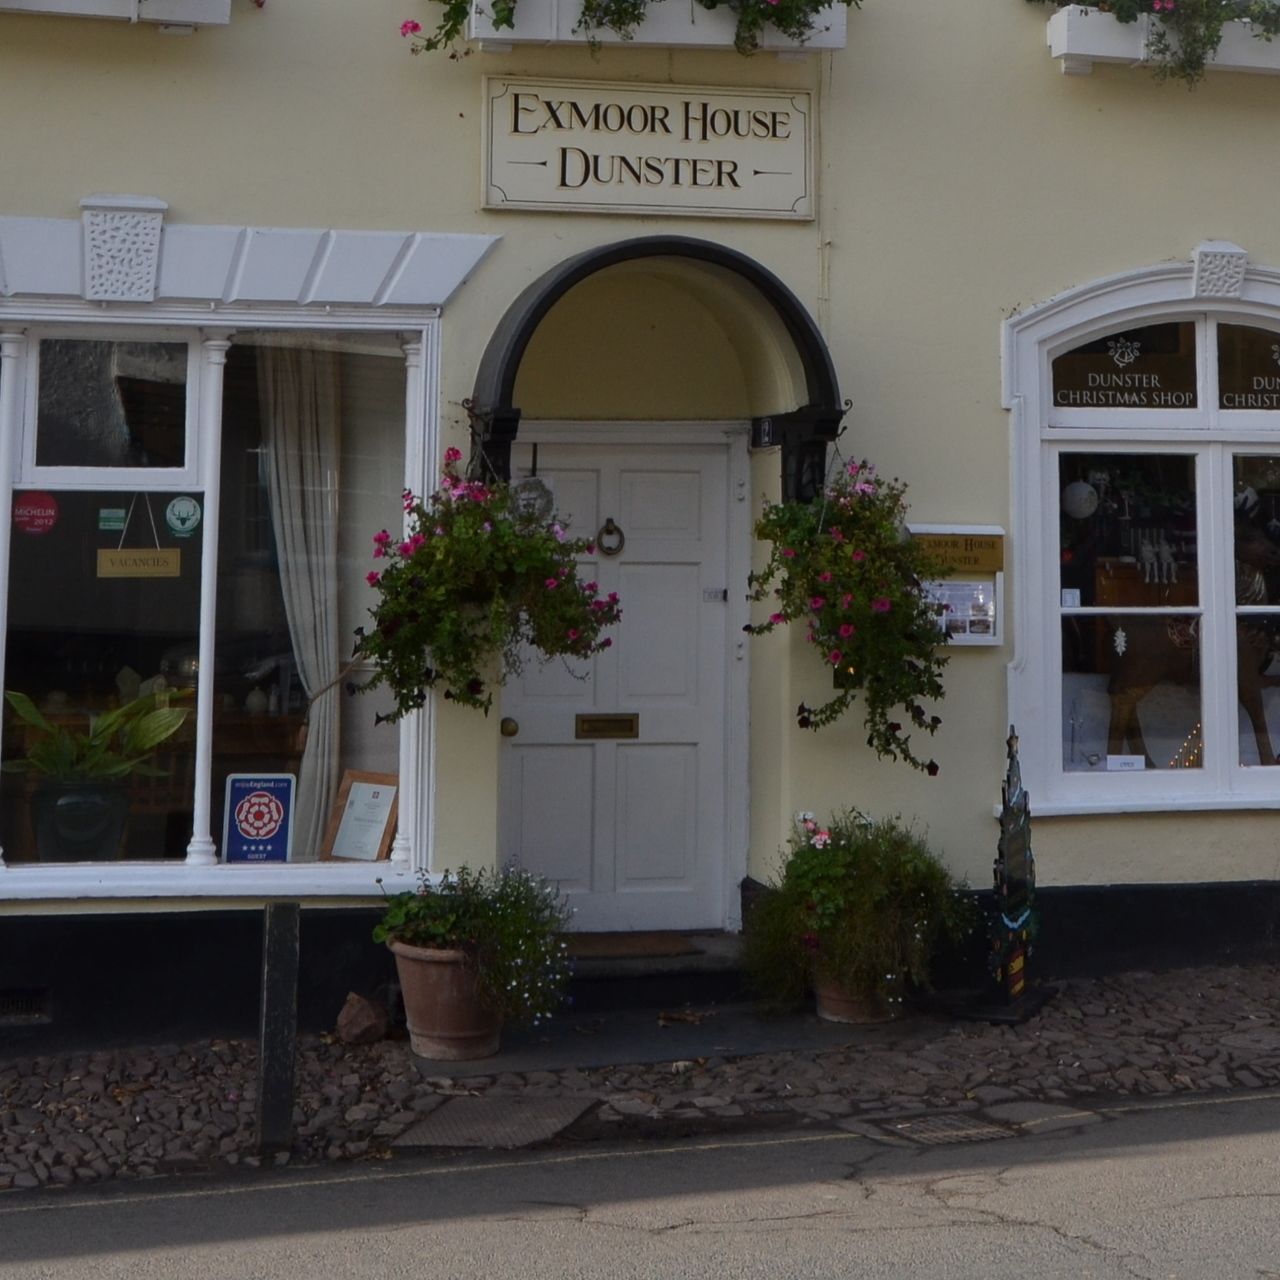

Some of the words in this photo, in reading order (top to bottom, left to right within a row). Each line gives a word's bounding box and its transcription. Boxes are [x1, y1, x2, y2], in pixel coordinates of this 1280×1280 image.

[511, 92, 672, 135] EXMOOR
[682, 101, 791, 141] HOUSE
[558, 147, 741, 188] DUNSTER
[1088, 372, 1161, 388] DUNSTER
[1056, 389, 1147, 405] CHRISTMAS
[1152, 391, 1193, 406] SHOP
[14, 508, 55, 517] MICHELIN
[110, 557, 169, 568] VACANCIES
